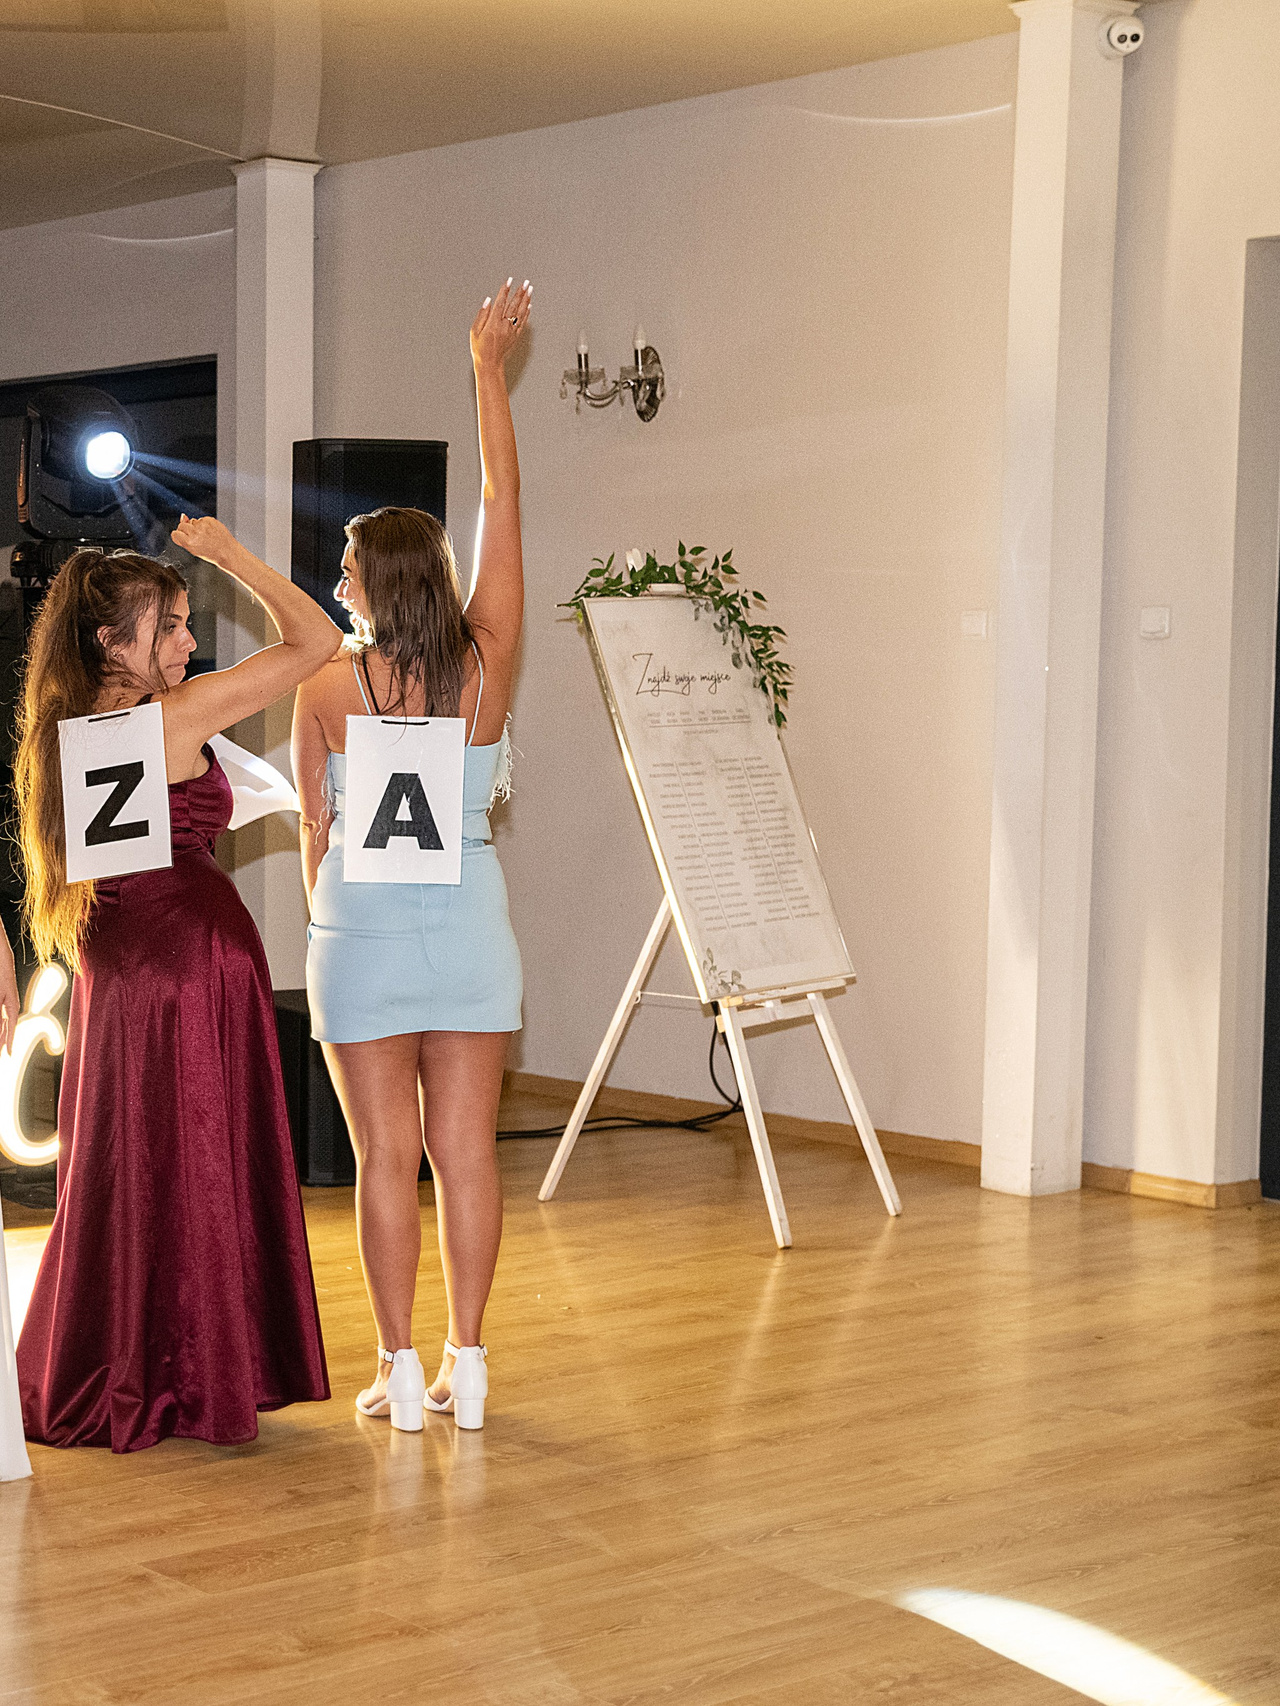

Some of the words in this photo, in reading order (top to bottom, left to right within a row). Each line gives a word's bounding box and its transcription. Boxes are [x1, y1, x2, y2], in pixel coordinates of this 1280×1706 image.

[674, 671, 697, 696] swoje
[700, 670, 732, 695] miejsce
[84, 760, 150, 847] Z
[362, 772, 445, 851] A
